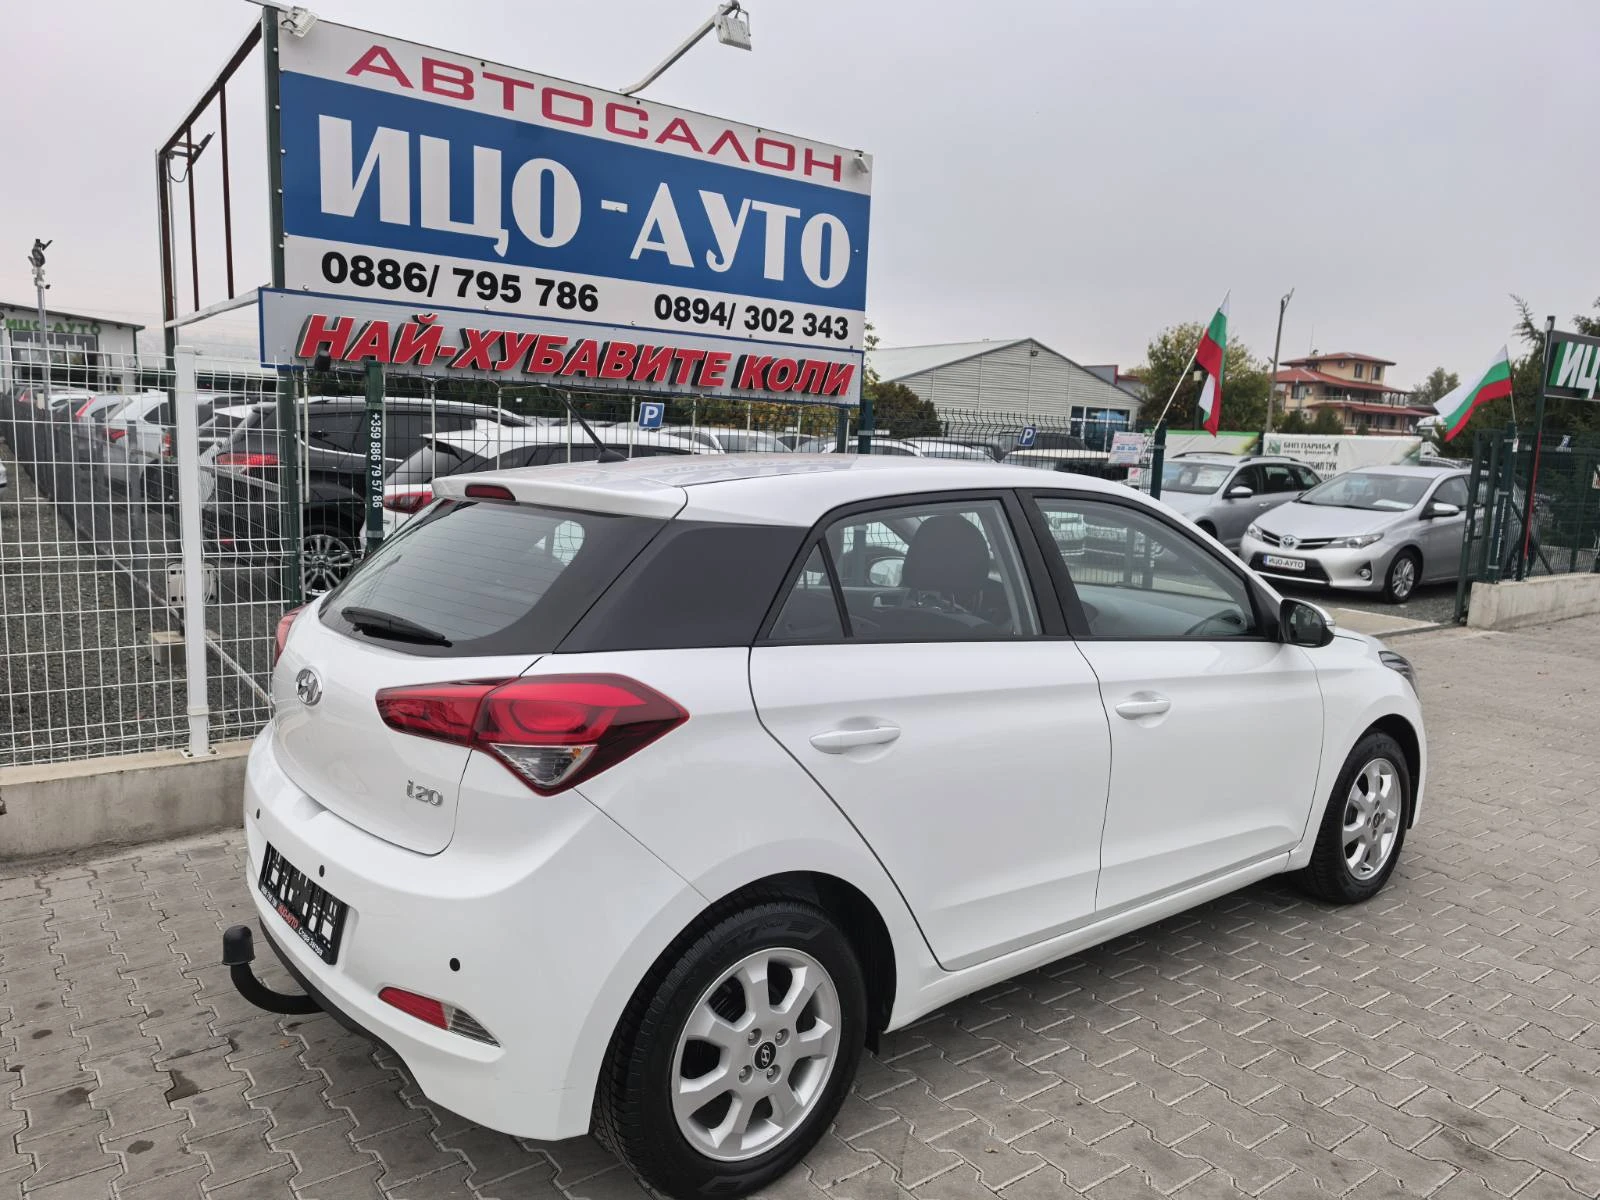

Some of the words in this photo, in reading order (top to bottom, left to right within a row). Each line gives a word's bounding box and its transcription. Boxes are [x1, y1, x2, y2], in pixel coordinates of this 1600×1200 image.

[345, 45, 842, 182] АВТОСАЛОН
[321, 251, 440, 297] 0886/
[452, 267, 522, 303] 795
[535, 278, 599, 312] 786
[654, 293, 737, 330] 0894/
[744, 305, 794, 334] 302
[802, 312, 849, 340] 343
[297, 313, 732, 387] НАЙ-ХУБАВИТЕ
[735, 354, 856, 397] КОЛИ
[370, 413, 381, 439] +359
[643, 405, 659, 425] P
[1022, 428, 1034, 444] P
[370, 442, 381, 461] 886
[371, 464, 382, 477] 79
[372, 480, 382, 492] 57
[372, 495, 383, 508] 86
[407, 780, 443, 807] i20
